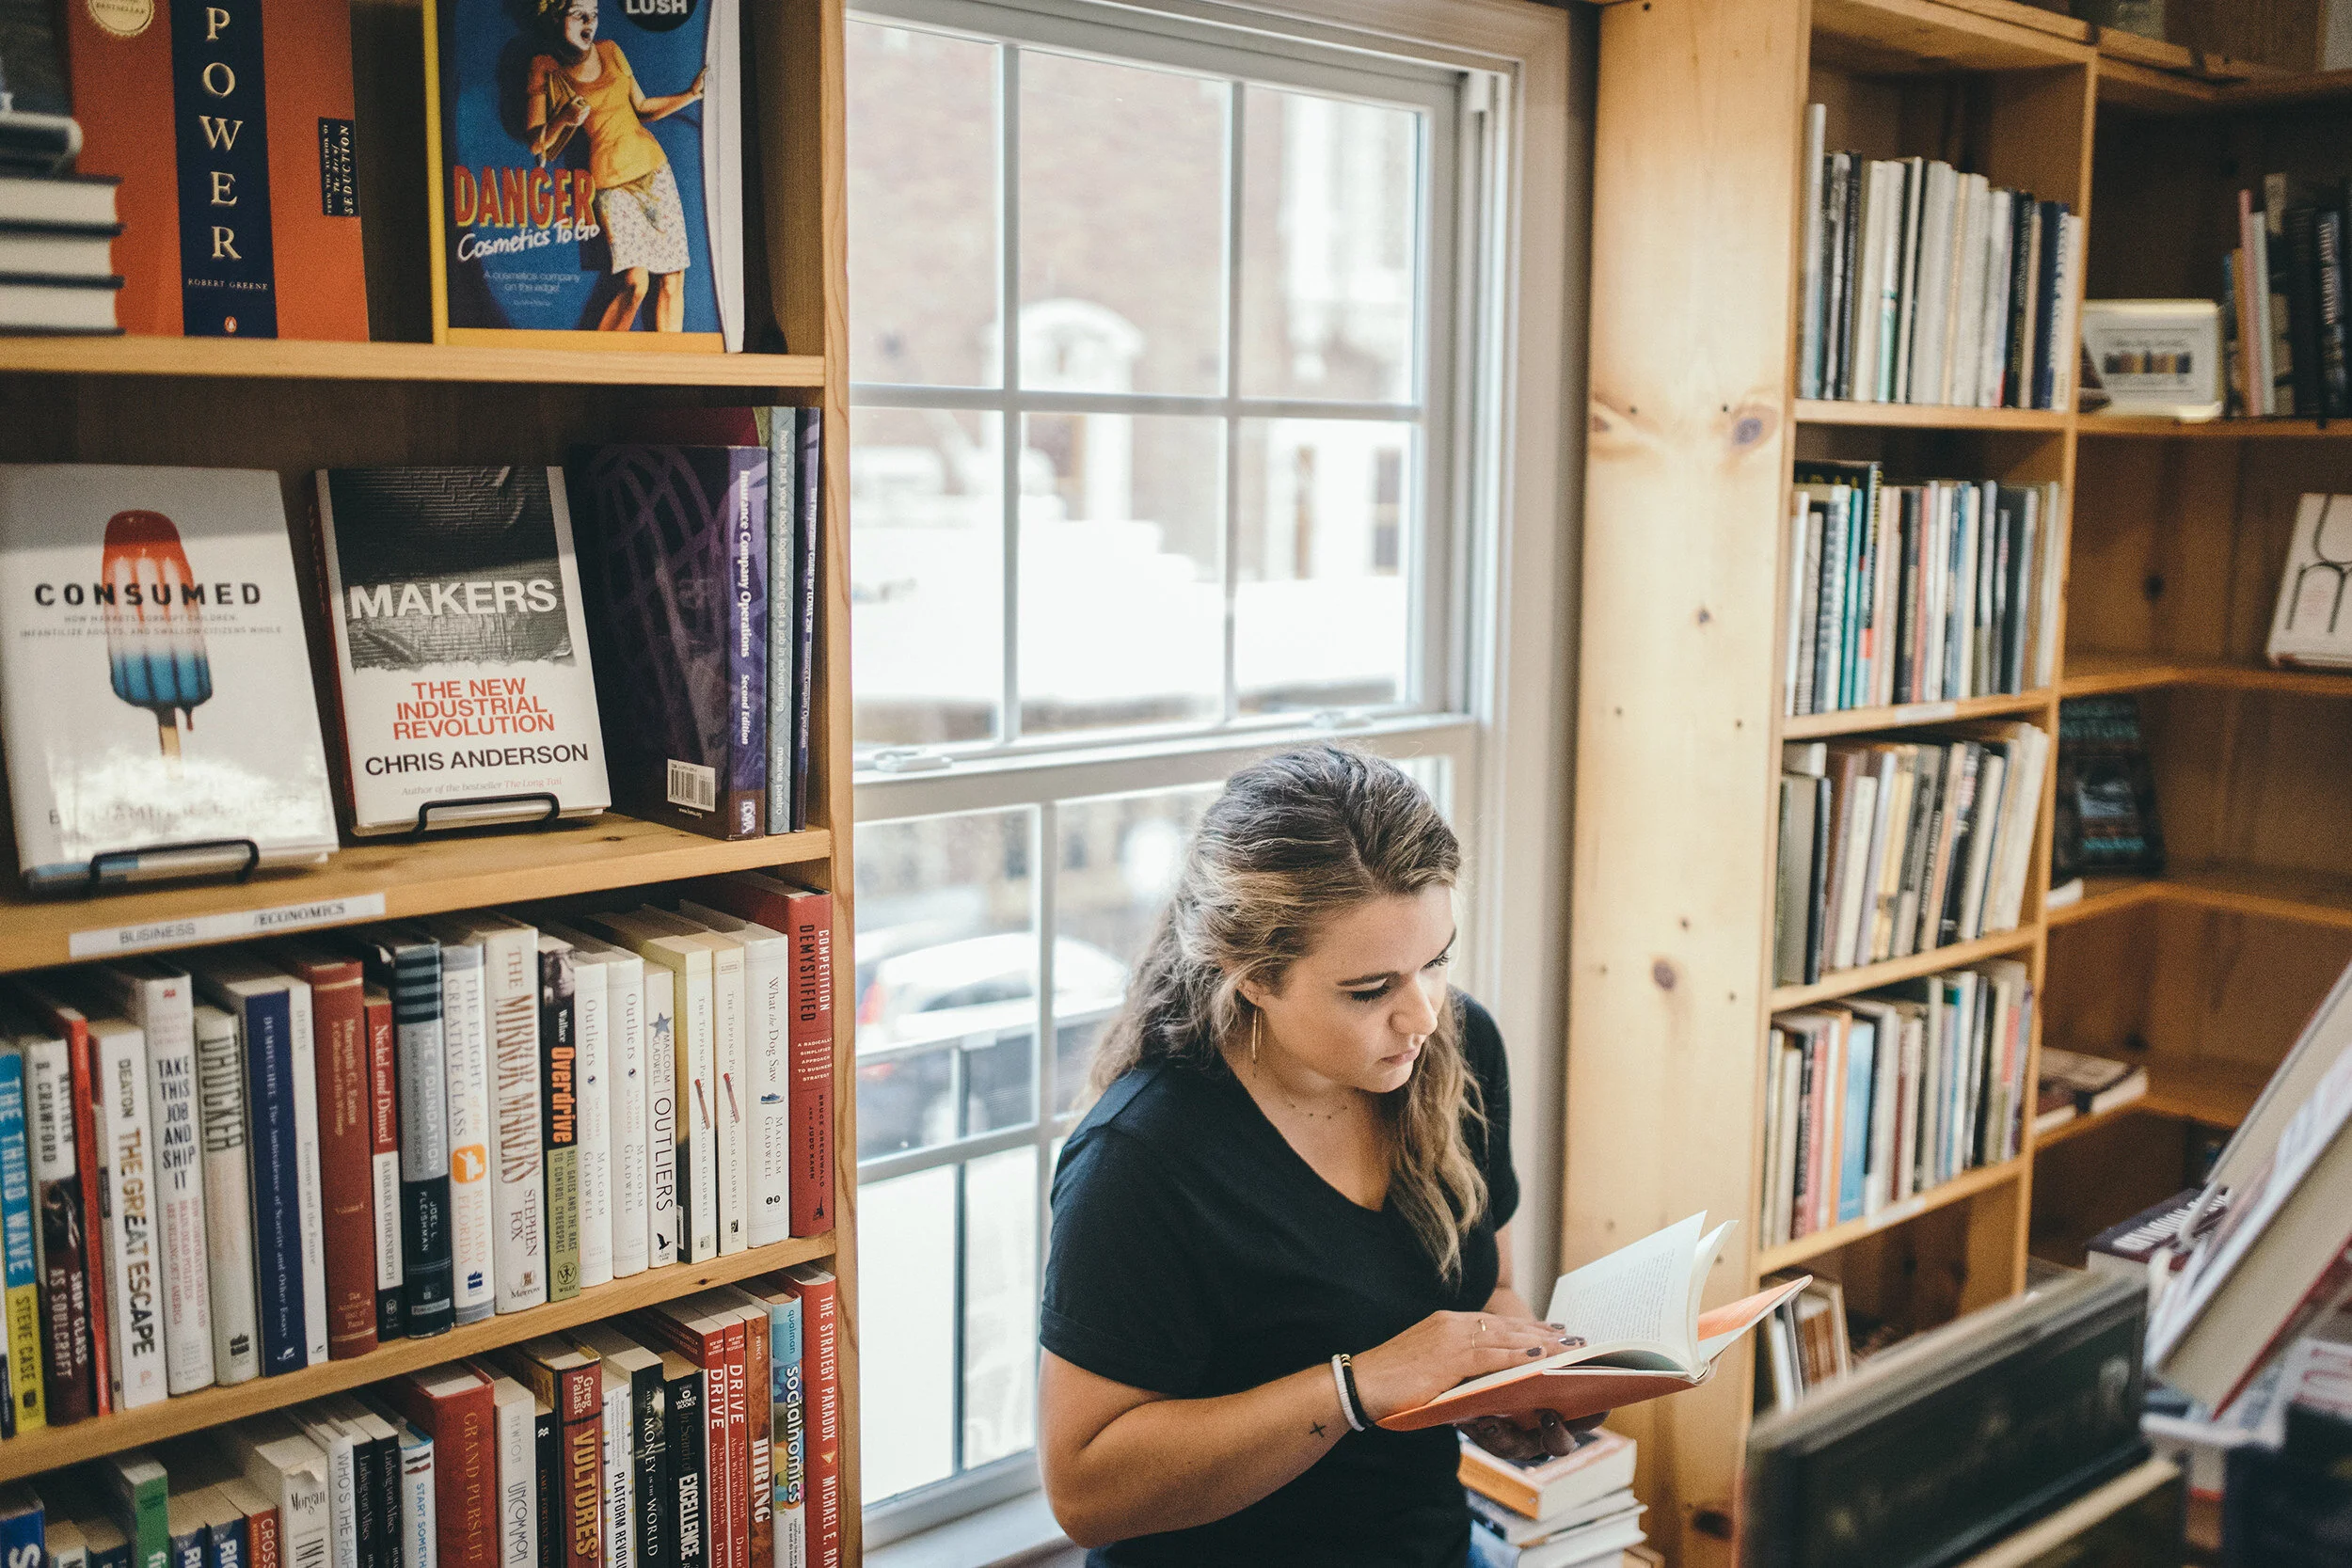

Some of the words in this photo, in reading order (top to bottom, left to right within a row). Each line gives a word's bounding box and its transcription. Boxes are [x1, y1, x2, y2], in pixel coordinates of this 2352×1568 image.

[627, 0, 688, 14] LUSH
[340, 125, 354, 214] SEDUCTION
[453, 165, 596, 229] DANGER
[457, 228, 550, 261] Cosmetics
[552, 217, 573, 245] To
[573, 218, 600, 243] Go
[188, 277, 225, 289] ROBERT
[229, 280, 269, 292] GREENE
[778, 430, 787, 452] how
[779, 453, 788, 464] to
[776, 467, 787, 484] put
[739, 470, 751, 529] Insurance
[776, 486, 787, 508] your
[778, 511, 787, 535] book
[738, 531, 752, 589] Company
[776, 538, 787, 579] together
[34, 582, 261, 607] CONSUMED
[349, 578, 558, 619] MAKERS
[778, 581, 787, 600] and
[738, 591, 752, 658] Operations
[776, 603, 787, 619] get
[776, 629, 787, 647] job
[411, 680, 464, 700] THE
[469, 677, 528, 698] NEW
[741, 674, 751, 709] Second
[776, 659, 787, 713] advertising
[802, 677, 810, 709] Company
[392, 713, 556, 740] REVOLUTION
[396, 696, 548, 721] INDUSTRIAL
[741, 711, 751, 745] Edition
[801, 710, 809, 748] Operations
[365, 752, 445, 776] CHRIS
[451, 743, 589, 769] ANDERSON
[777, 747, 786, 782] maxine
[774, 784, 785, 816] paetro
[119, 923, 196, 943] BUSINESS
[508, 948, 524, 990] THE
[800, 924, 816, 1022] DEMYSTIFIED
[818, 929, 831, 1011] COMPETITION
[769, 976, 779, 1011] What
[447, 979, 464, 1077] CREATIVE
[558, 1009, 568, 1043] Wallace
[585, 1000, 599, 1067] Outliers
[626, 993, 639, 1060] Outliers
[769, 1014, 779, 1027] the
[374, 1024, 389, 1067] Nickel
[422, 1026, 435, 1060] THE
[496, 993, 536, 1091] MIRROR
[653, 1035, 661, 1086] GLADWELL
[765, 1029, 780, 1057] Dog
[800, 1046, 832, 1056] SIMPLIFIED
[802, 1055, 831, 1065] APPROACH
[157, 1055, 189, 1079] TAKE
[376, 1069, 390, 1097] and
[769, 1059, 780, 1083] Saw
[803, 1072, 830, 1082] STRATEGY
[0, 1076, 22, 1122] THE
[119, 1057, 135, 1119] DEATON
[160, 1079, 190, 1101] THIS
[200, 1033, 244, 1152] DRUCKER
[550, 1046, 577, 1144] Overdrive
[166, 1101, 189, 1123] JOB
[376, 1098, 393, 1144] Dimed
[424, 1065, 438, 1170] FOUNDATION
[453, 1080, 468, 1137] CLASS
[119, 1128, 144, 1177] THE
[164, 1123, 192, 1147] AND
[499, 1092, 541, 1184] MAKERS
[654, 1097, 674, 1212] OUTLIERS
[764, 1116, 774, 1180] GLADWELL
[1, 1131, 29, 1201] THIRD
[162, 1145, 196, 1170] SHIP
[553, 1152, 564, 1163] TO
[566, 1149, 576, 1167] BILL
[174, 1169, 187, 1191] IT
[381, 1161, 392, 1209] BARBARA
[554, 1165, 564, 1203] CONTROL
[567, 1169, 577, 1193] GATES
[122, 1178, 149, 1255] GREAT
[419, 1191, 429, 1252] FLEISHMAN
[524, 1189, 538, 1258] STEPHEN
[567, 1196, 577, 1212] AND
[567, 1213, 577, 1229] THE
[7, 1210, 34, 1275] WAVE
[384, 1211, 395, 1280] EHRENREICH
[458, 1196, 469, 1265] FLORIDA
[473, 1190, 486, 1265] RICHARD
[511, 1211, 524, 1243] FOX
[555, 1205, 564, 1255] CYBERSPACE
[568, 1231, 578, 1252] RACE
[50, 1269, 66, 1286] AS
[71, 1270, 85, 1310] SHOP
[16, 1296, 33, 1340] STEVE
[128, 1260, 155, 1357] ESCAPE
[820, 1294, 834, 1320] THE
[53, 1293, 72, 1379] SOULCRAFT
[74, 1317, 87, 1365] CLASS
[787, 1309, 797, 1354] qualman
[20, 1346, 36, 1382] CASE
[820, 1323, 835, 1381] STRATEGY
[572, 1374, 584, 1416] Palast
[581, 1376, 594, 1407] Greg
[710, 1369, 724, 1430] DRiVE
[729, 1364, 744, 1424] DRiVE
[820, 1386, 836, 1441] PARADOX
[464, 1412, 479, 1478] GRAND
[644, 1418, 658, 1473] MONEY
[787, 1366, 804, 1503] socialnomics
[358, 1455, 371, 1494] Ludwig
[383, 1449, 397, 1487] Ludwig
[753, 1437, 771, 1523] HIRING
[291, 1491, 326, 1515] Morgan
[360, 1494, 370, 1512] von
[386, 1487, 395, 1504] von
[416, 1482, 426, 1517] START
[361, 1513, 373, 1542] Mises
[387, 1505, 398, 1534] Mises
[467, 1484, 483, 1561] PURSUIT
[508, 1481, 529, 1565] UNCOMMON
[646, 1497, 659, 1556] WORLD
